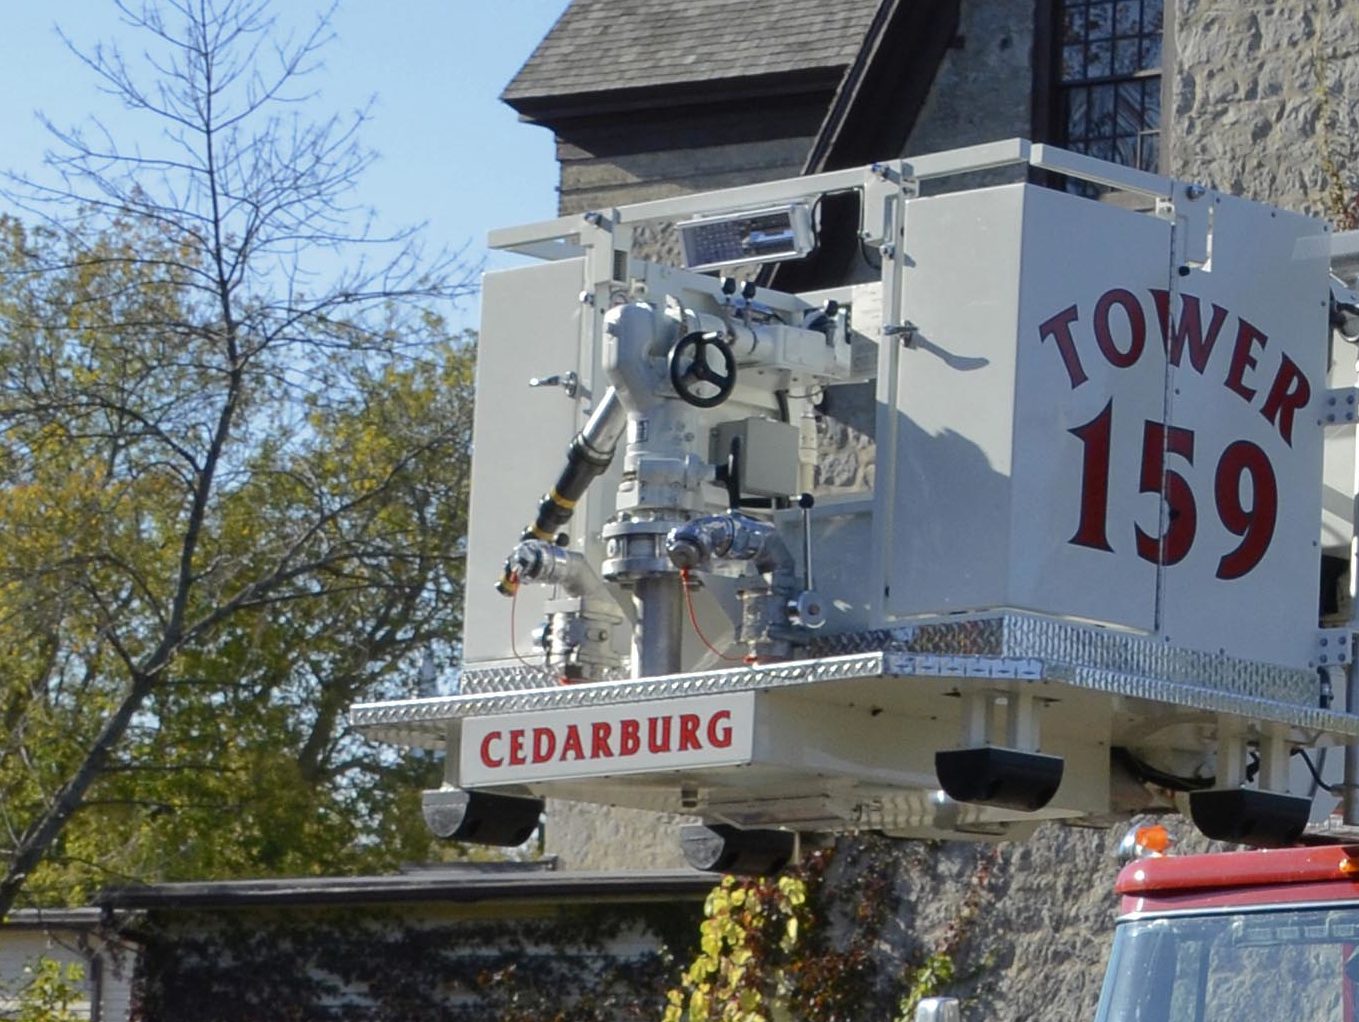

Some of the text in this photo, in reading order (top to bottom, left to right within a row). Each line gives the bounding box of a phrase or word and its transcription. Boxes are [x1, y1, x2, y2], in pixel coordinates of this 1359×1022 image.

[1039, 288, 1311, 448] TOWER
[1066, 396, 1279, 580] 159
[480, 709, 733, 768] CEDARBURG
